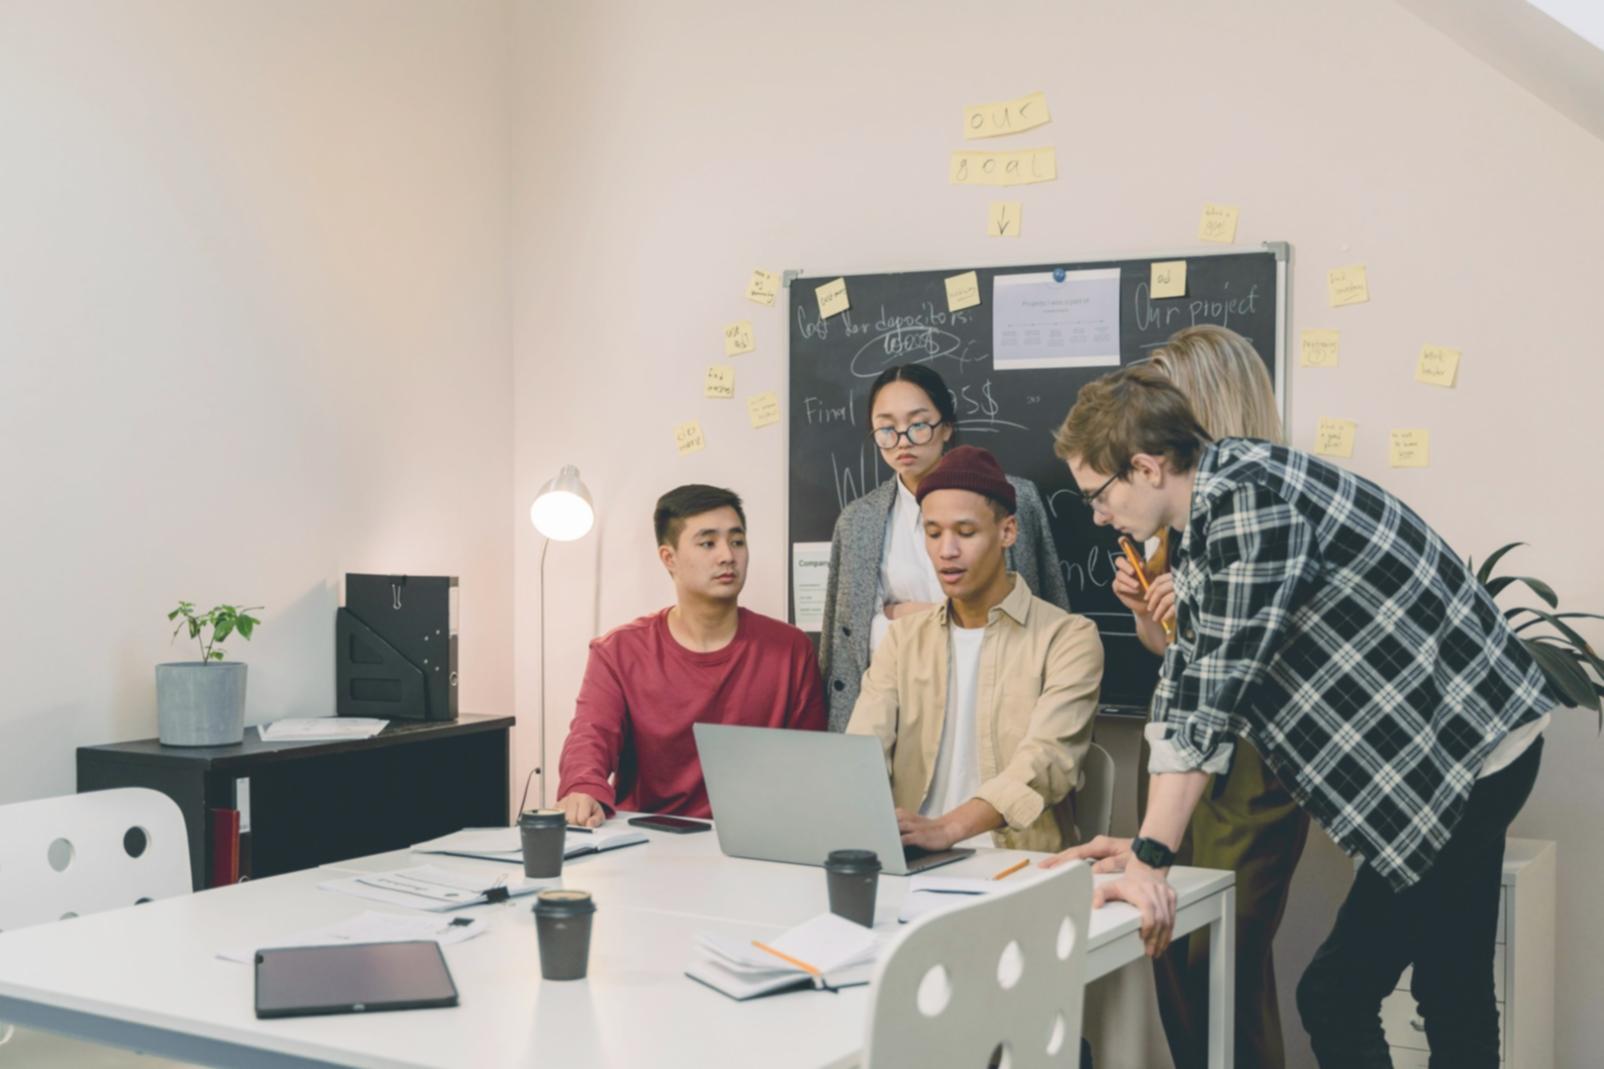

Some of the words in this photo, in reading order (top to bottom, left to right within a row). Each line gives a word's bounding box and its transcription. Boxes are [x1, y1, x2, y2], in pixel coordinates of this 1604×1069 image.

[955, 152, 1044, 182] goal
[1135, 282, 1181, 331] Our
[1189, 281, 1260, 328] project
[804, 390, 856, 427] Final
